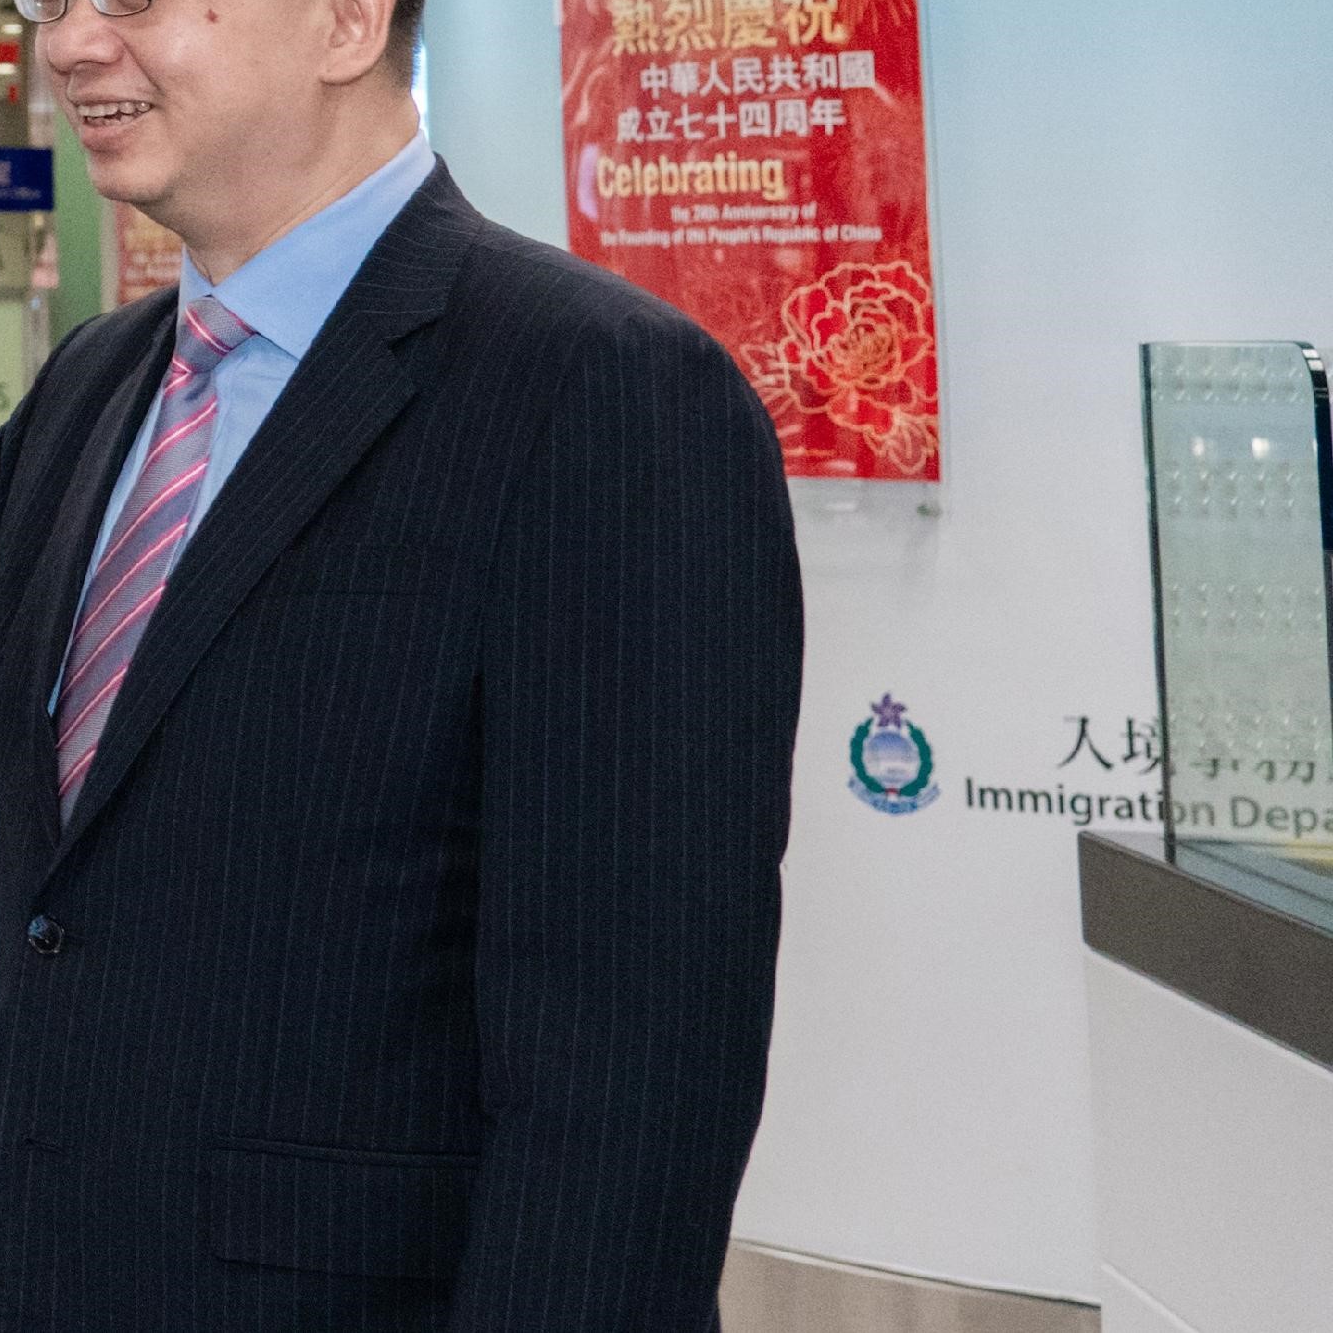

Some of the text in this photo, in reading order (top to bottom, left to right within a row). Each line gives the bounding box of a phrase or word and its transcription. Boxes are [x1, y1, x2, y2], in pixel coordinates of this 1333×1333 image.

[640, 50, 876, 99] 中華人民共和國
[617, 97, 847, 144] 成立七十四周年
[597, 150, 787, 201] Celebrating
[722, 202, 800, 223] Anniversary
[839, 223, 883, 242] China
[966, 776, 1215, 826] Immigration
